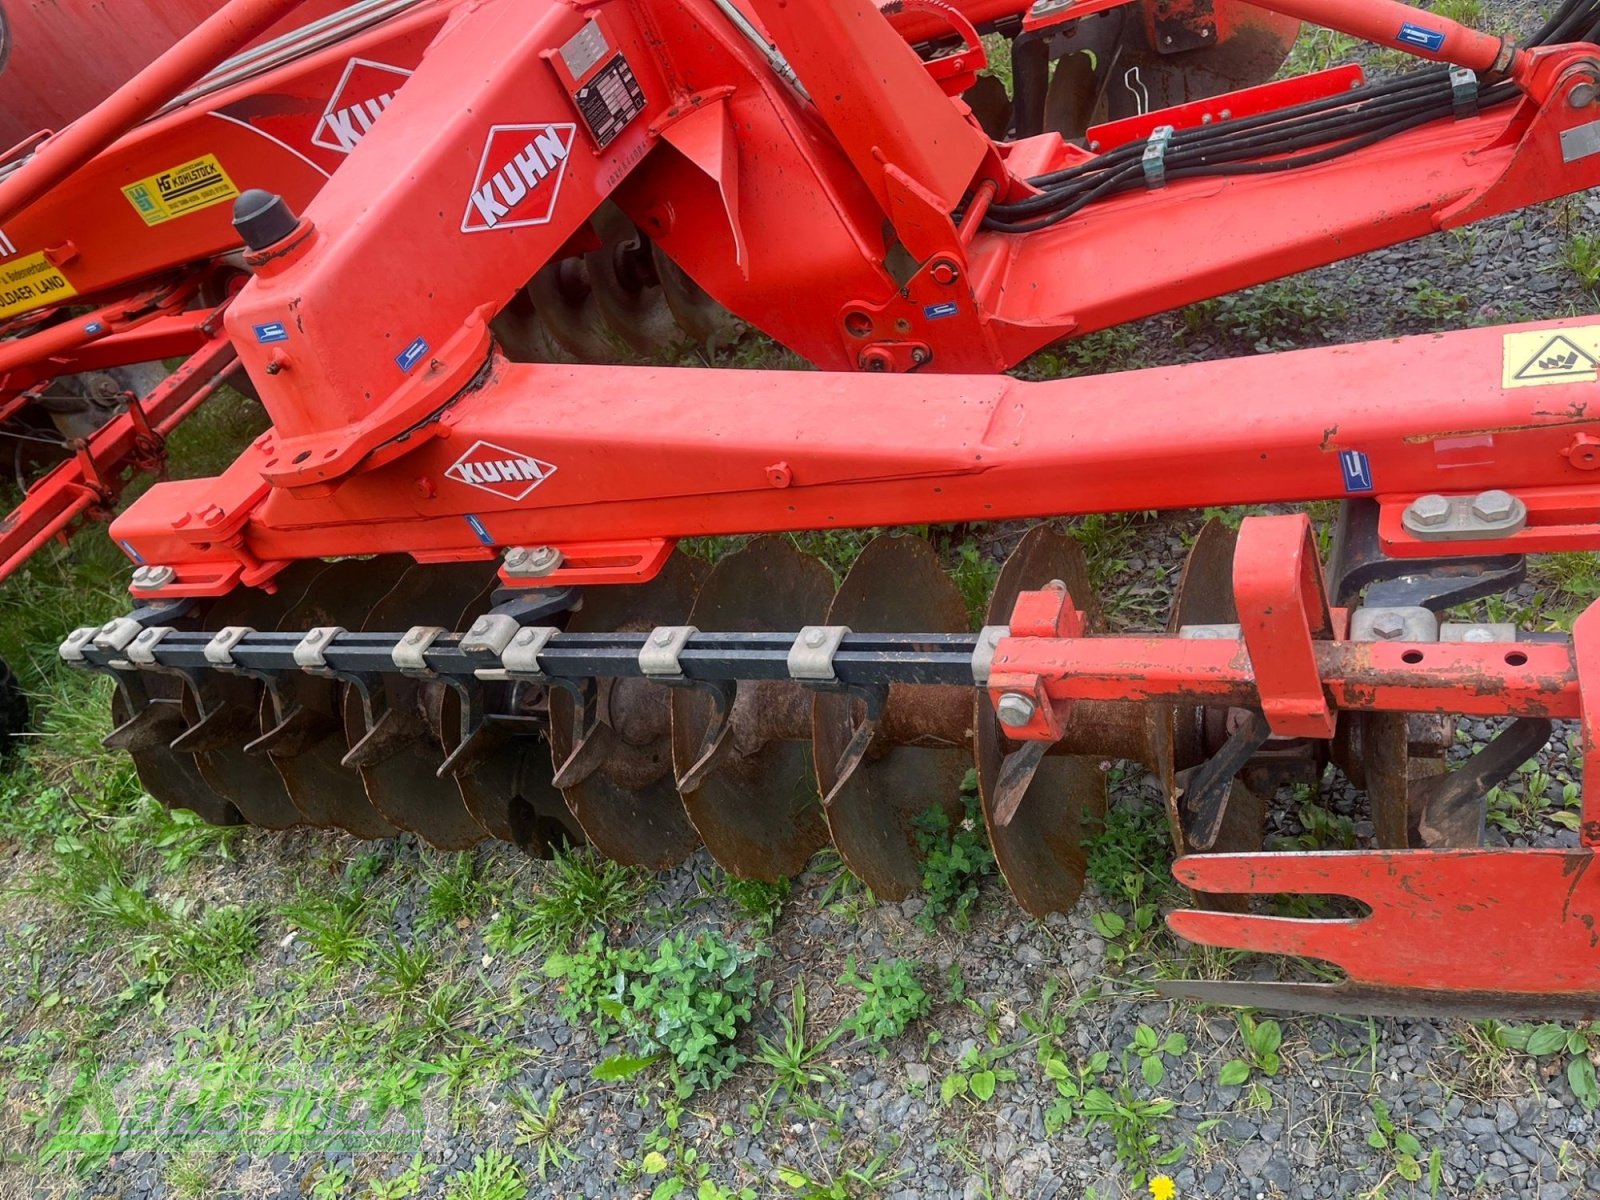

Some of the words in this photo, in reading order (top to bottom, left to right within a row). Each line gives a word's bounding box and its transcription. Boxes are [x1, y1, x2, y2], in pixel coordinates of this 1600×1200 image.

[324, 88, 401, 149] KU
[171, 163, 218, 188] KOHLSTOCK
[471, 125, 568, 228] KUHN
[33, 275, 65, 294] LAND
[455, 457, 545, 484] KUHN
